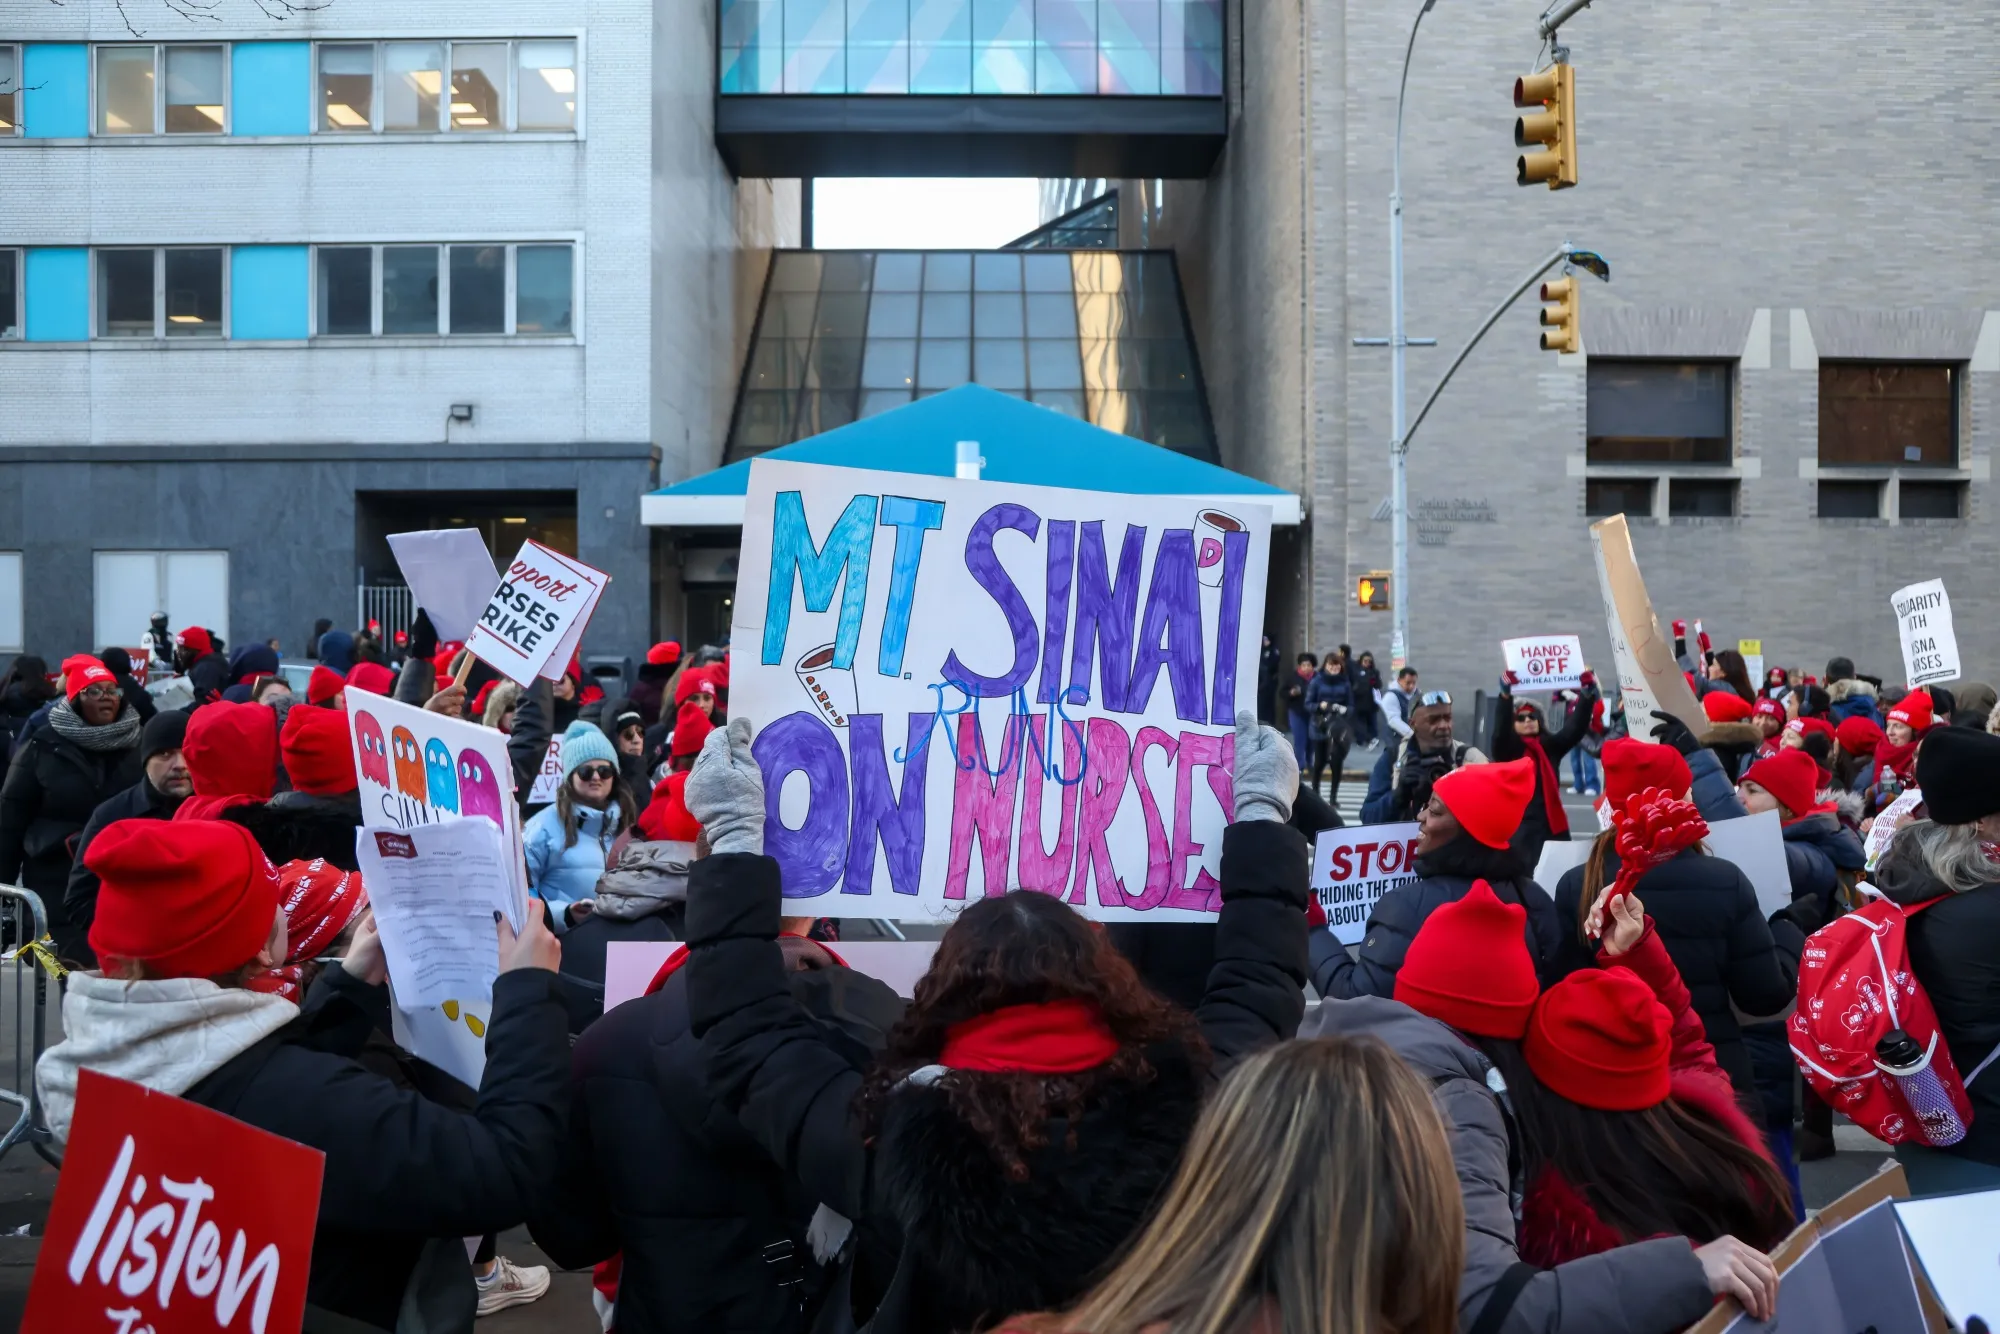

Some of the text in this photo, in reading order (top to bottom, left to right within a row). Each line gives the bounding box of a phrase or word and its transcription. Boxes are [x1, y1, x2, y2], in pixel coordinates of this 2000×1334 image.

[1198, 537, 1223, 568] D
[762, 490, 1249, 726] MT. SINAI
[1520, 644, 1571, 658] HANDS
[1527, 657, 1568, 676] OFF
[1533, 674, 1580, 684] HEALTHCAR
[806, 676, 844, 725] DUNKIN
[894, 680, 1090, 786] RUNS
[751, 711, 936, 899] ON
[1330, 839, 1419, 881] STOP
[1320, 882, 1363, 905] HIDING
[1366, 879, 1389, 898] THE
[1327, 903, 1366, 926] ABOUT
